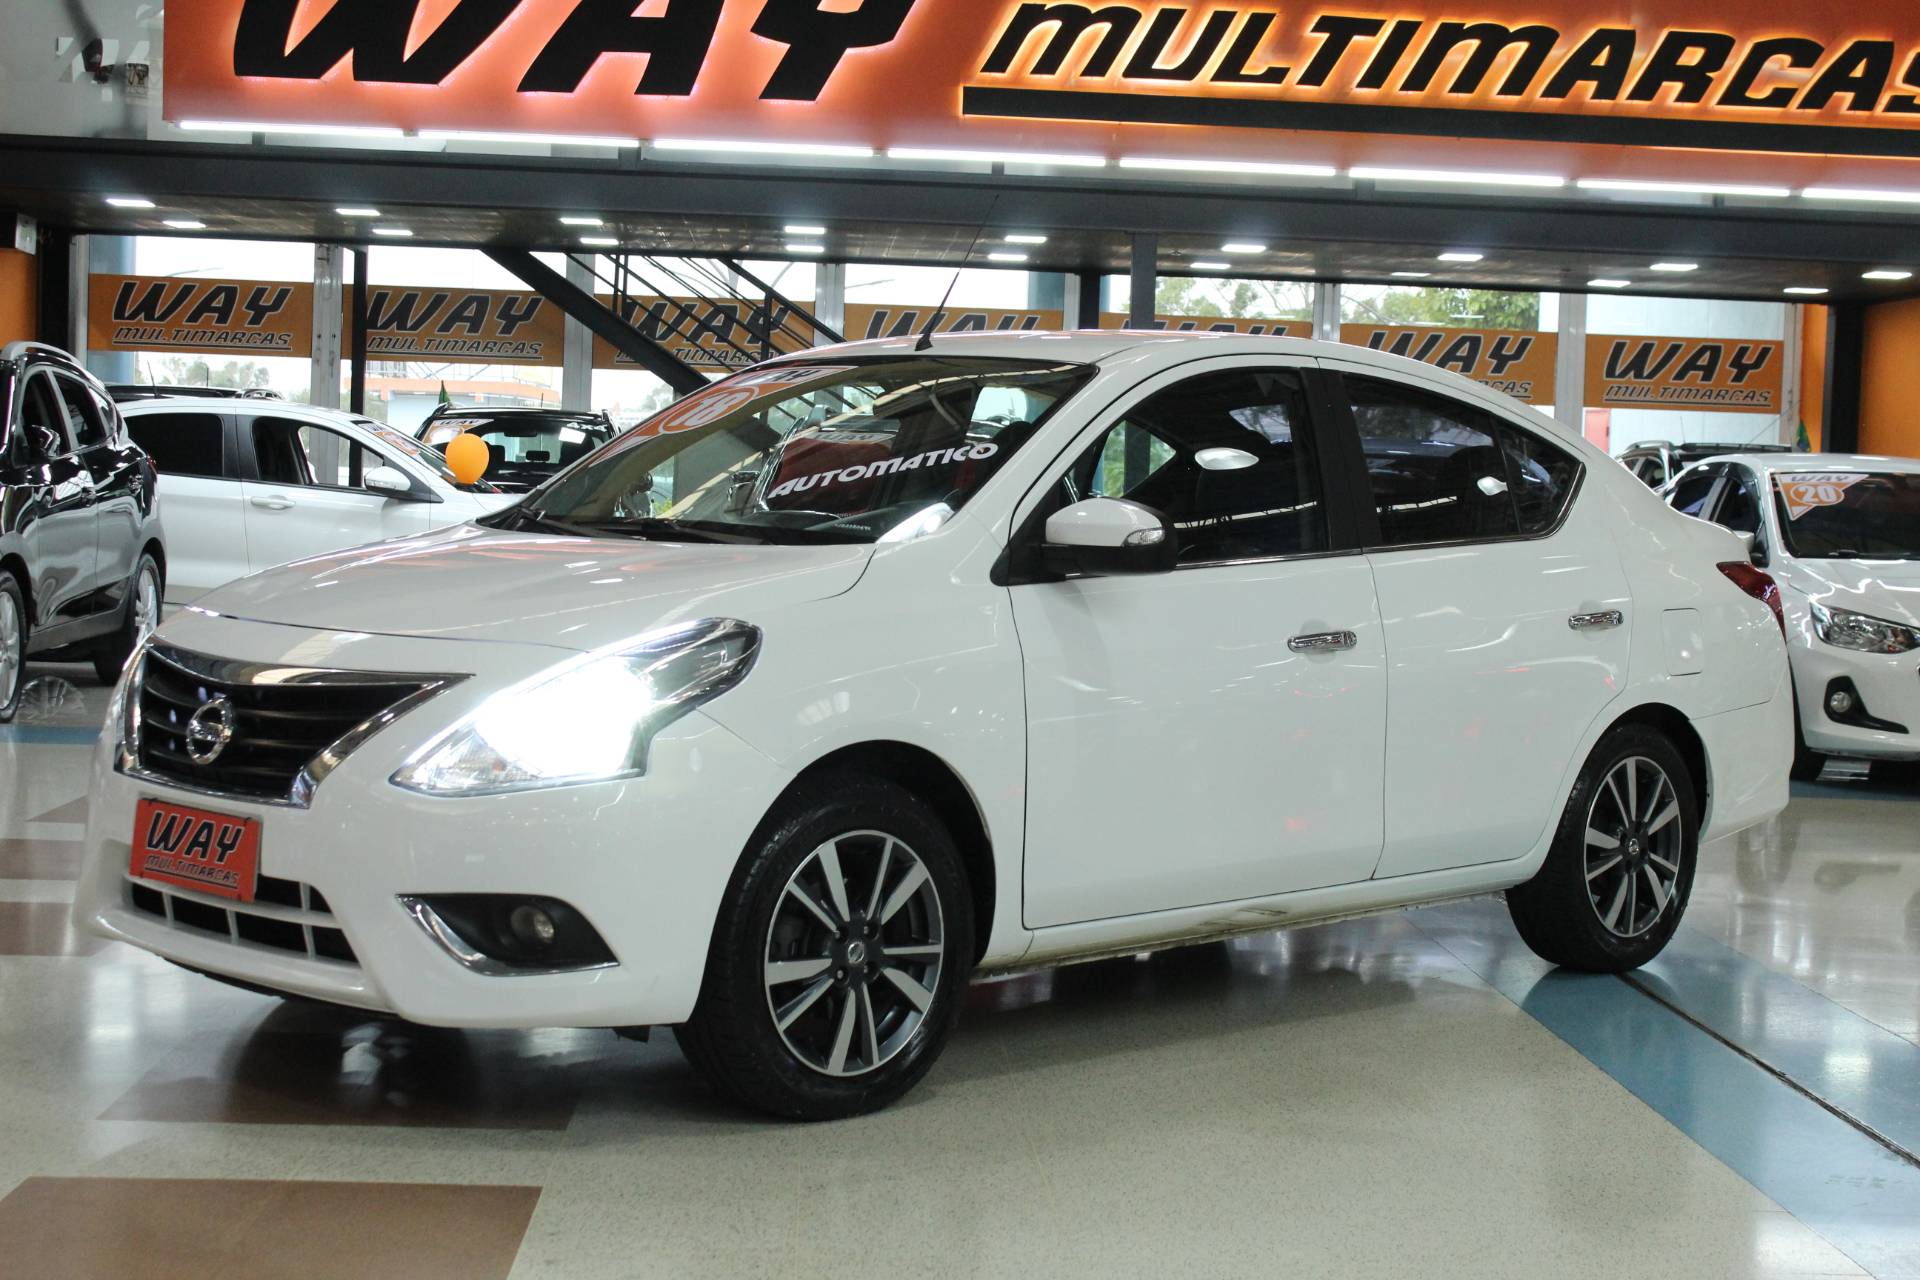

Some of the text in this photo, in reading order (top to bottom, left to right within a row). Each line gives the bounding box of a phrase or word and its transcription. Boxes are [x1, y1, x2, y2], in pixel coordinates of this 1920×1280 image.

[112, 280, 293, 327] WAY
[367, 290, 545, 337] WAY
[114, 327, 293, 346] MULTIMARCAS
[367, 336, 544, 355] MULTIMARCAS
[1603, 340, 1775, 384] WAY
[669, 391, 751, 427] 18
[1604, 384, 1772, 402] MULTIMARCAS
[767, 442, 999, 500] AUTOMATICO
[1796, 485, 1838, 503] 20
[145, 810, 245, 864] WAY
[145, 855, 240, 884] MULTIMARCAS
